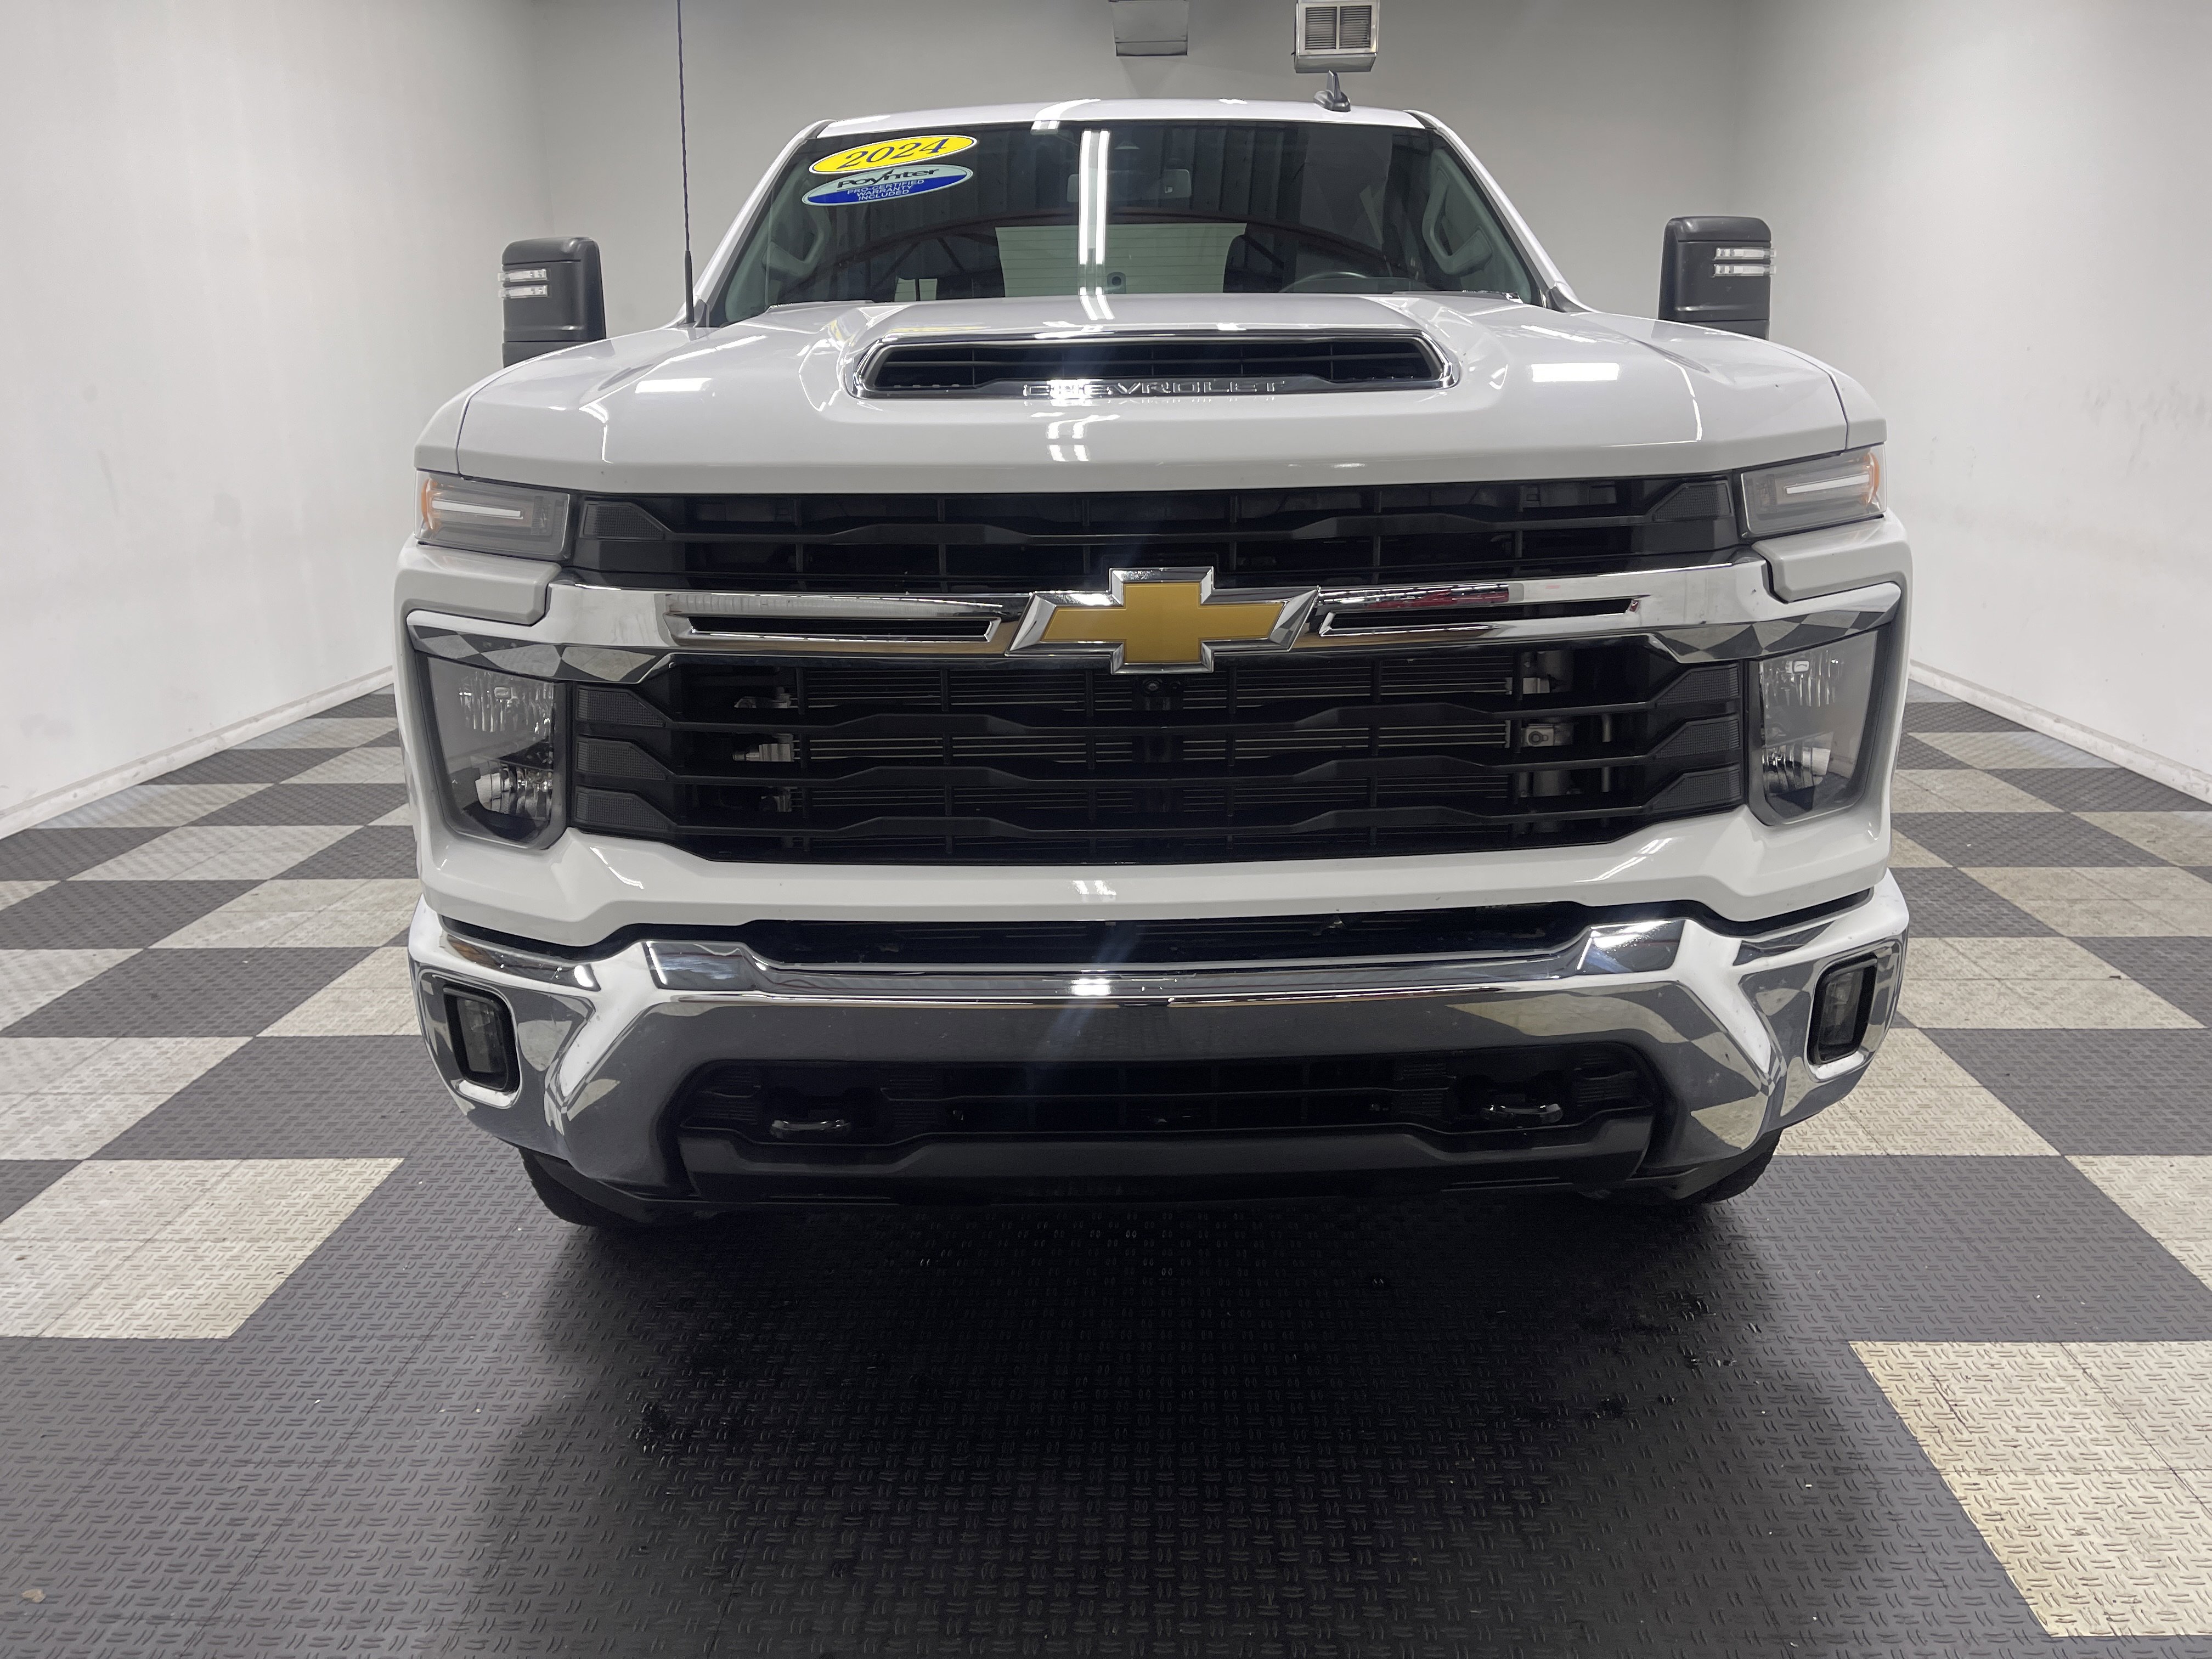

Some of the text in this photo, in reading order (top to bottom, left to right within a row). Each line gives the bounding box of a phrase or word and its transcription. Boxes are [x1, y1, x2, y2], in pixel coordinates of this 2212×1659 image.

[837, 138, 949, 169] 2024
[847, 179, 924, 194] PRO-CERTIFIED
[856, 185, 913, 196] WARRANTY
[859, 189, 909, 201] INCLUDED
